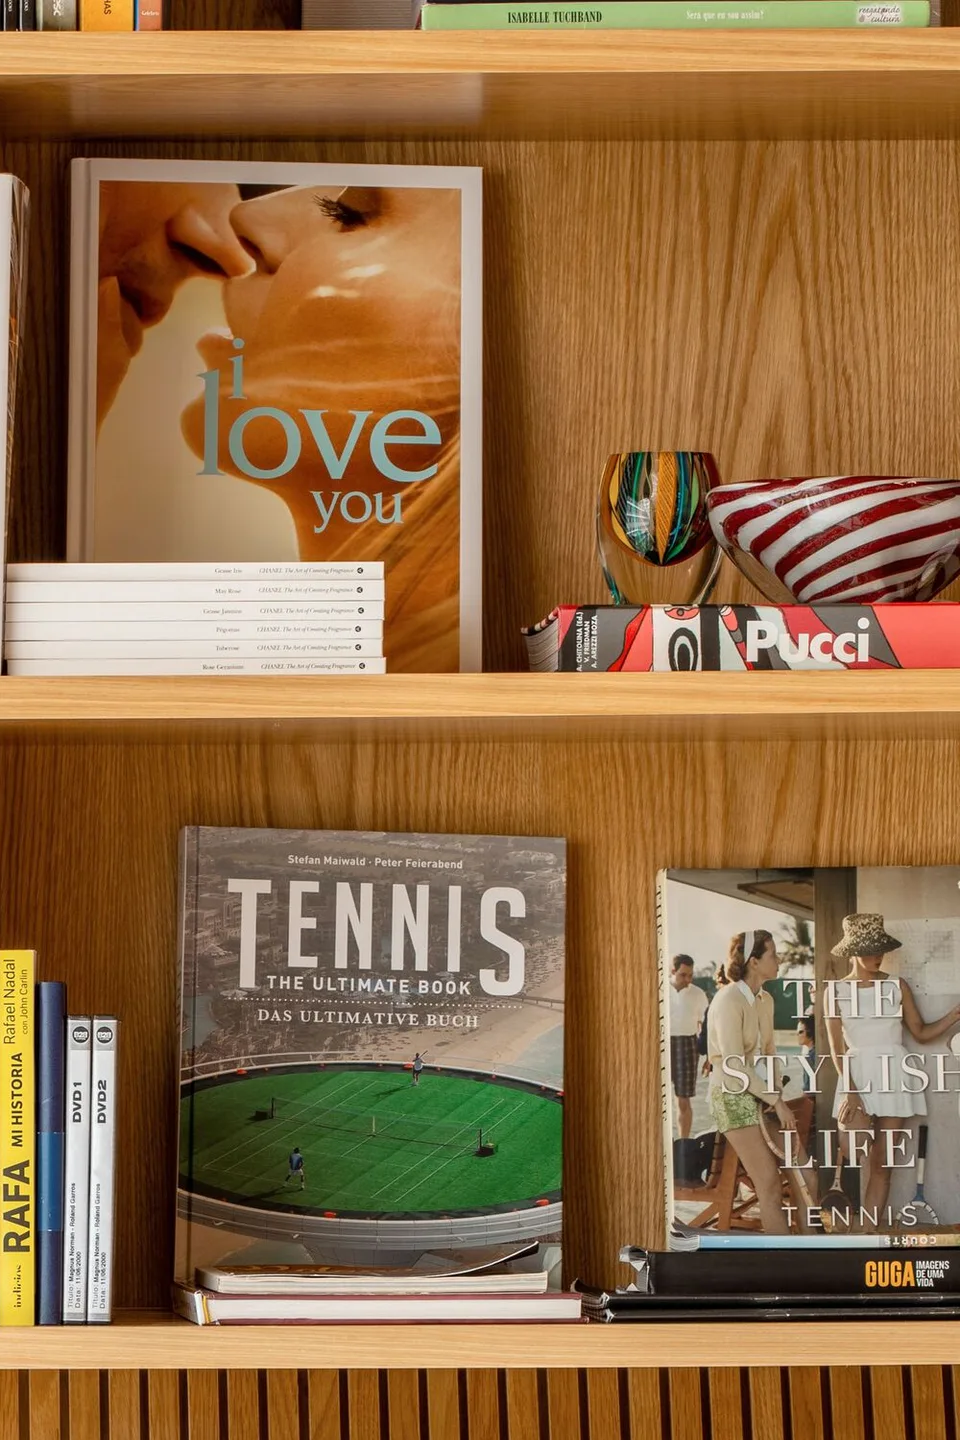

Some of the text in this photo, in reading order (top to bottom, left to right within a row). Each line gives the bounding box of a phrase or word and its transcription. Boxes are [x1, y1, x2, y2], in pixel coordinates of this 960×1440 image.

[507, 11, 603, 24] ISABELLE TUCHBAND
[227, 337, 248, 400] i
[195, 368, 443, 483] love
[309, 490, 405, 534] you
[746, 616, 871, 664] Pucci
[287, 854, 464, 870] Stefan Maiwald Peter Feierabend
[227, 877, 527, 997] TENNIS
[2, 958, 16, 1045] Rafael Nadal
[18, 968, 29, 1035] con John Carlin
[267, 975, 472, 995] THE ULTIMATE BOOK
[782, 978, 904, 1019] THE
[257, 1008, 479, 1029] DAS ULTIMATIVE BUCH
[720, 1053, 960, 1095] STYLISH
[10, 1051, 24, 1148] MI HISTORIA
[96, 1079, 108, 1124] DVD2
[778, 1128, 916, 1169] LIFE
[2, 1159, 31, 1253] RAFA
[781, 1205, 919, 1228] TENNIS
[883, 1235, 938, 1246] COURTS
[864, 1259, 916, 1288] GUGA
[915, 1259, 951, 1271] IMAGENS
[915, 1269, 945, 1279] DE UMA
[915, 1278, 935, 1288] VIDA
